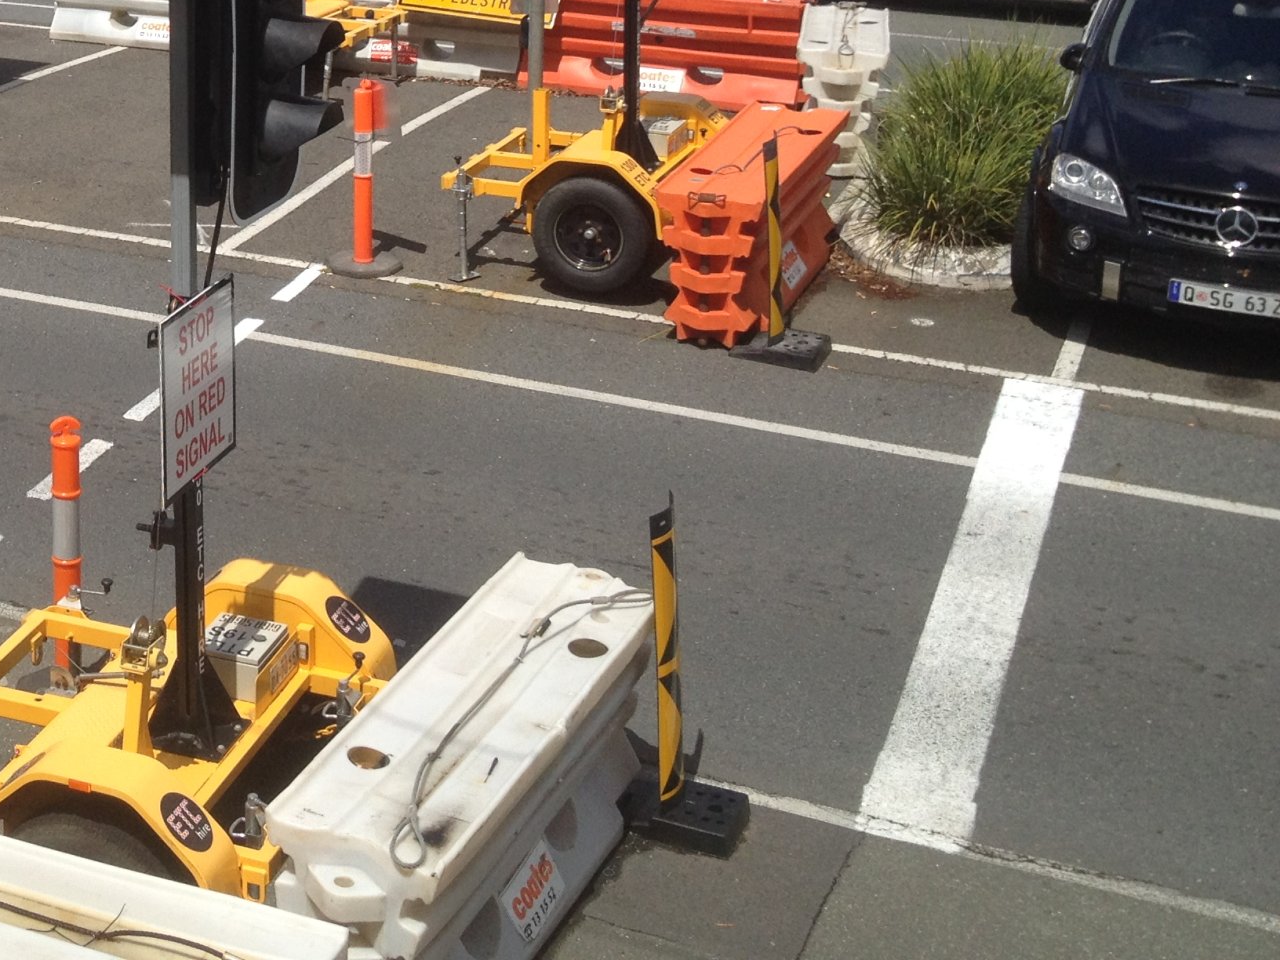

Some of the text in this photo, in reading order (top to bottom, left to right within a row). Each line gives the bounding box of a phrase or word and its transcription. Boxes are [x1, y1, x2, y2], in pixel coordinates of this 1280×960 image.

[639, 71, 676, 82] oates
[1209, 290, 1235, 309] SG
[1244, 295, 1267, 313] 63
[179, 305, 215, 356] STOP
[181, 341, 219, 395] HERE
[175, 376, 226, 440] ON RED
[175, 417, 226, 479] SIGNAL
[196, 526, 204, 582] ETC
[197, 603, 205, 675] HIRE
[331, 601, 361, 634] ETC
[355, 619, 369, 635] hire
[166, 798, 202, 840] ETC
[194, 823, 211, 840] hire
[511, 851, 553, 921] coates
